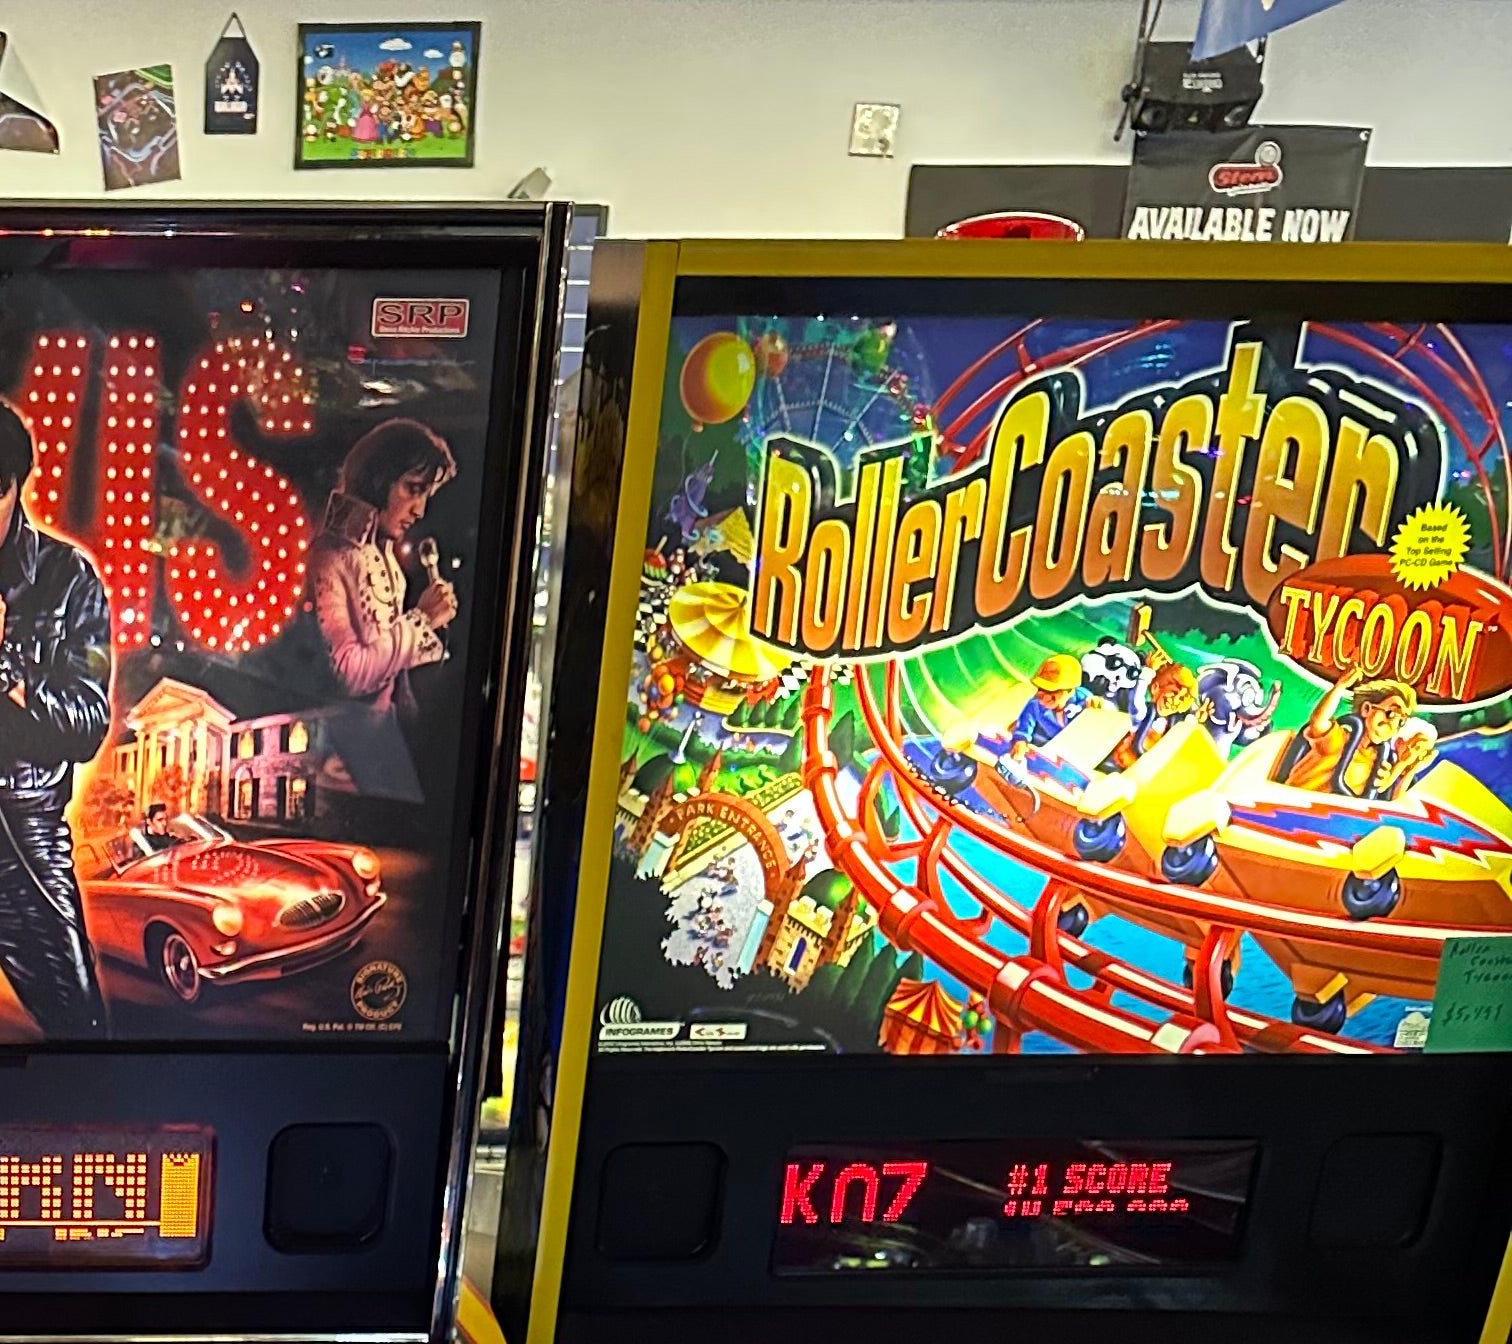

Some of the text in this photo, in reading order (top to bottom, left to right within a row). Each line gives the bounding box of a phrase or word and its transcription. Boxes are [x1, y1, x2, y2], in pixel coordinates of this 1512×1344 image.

[1128, 207, 1350, 242] AVAILABLE NOW
[378, 303, 464, 325] SRP
[751, 343, 1398, 653] RollerCoaster
[1281, 585, 1484, 700] TYCOON
[676, 803, 715, 820] PARK
[719, 806, 777, 869] ENTRANCE
[605, 1027, 674, 1036] INFOGRAMES
[1064, 1162, 1173, 1194] SCORE
